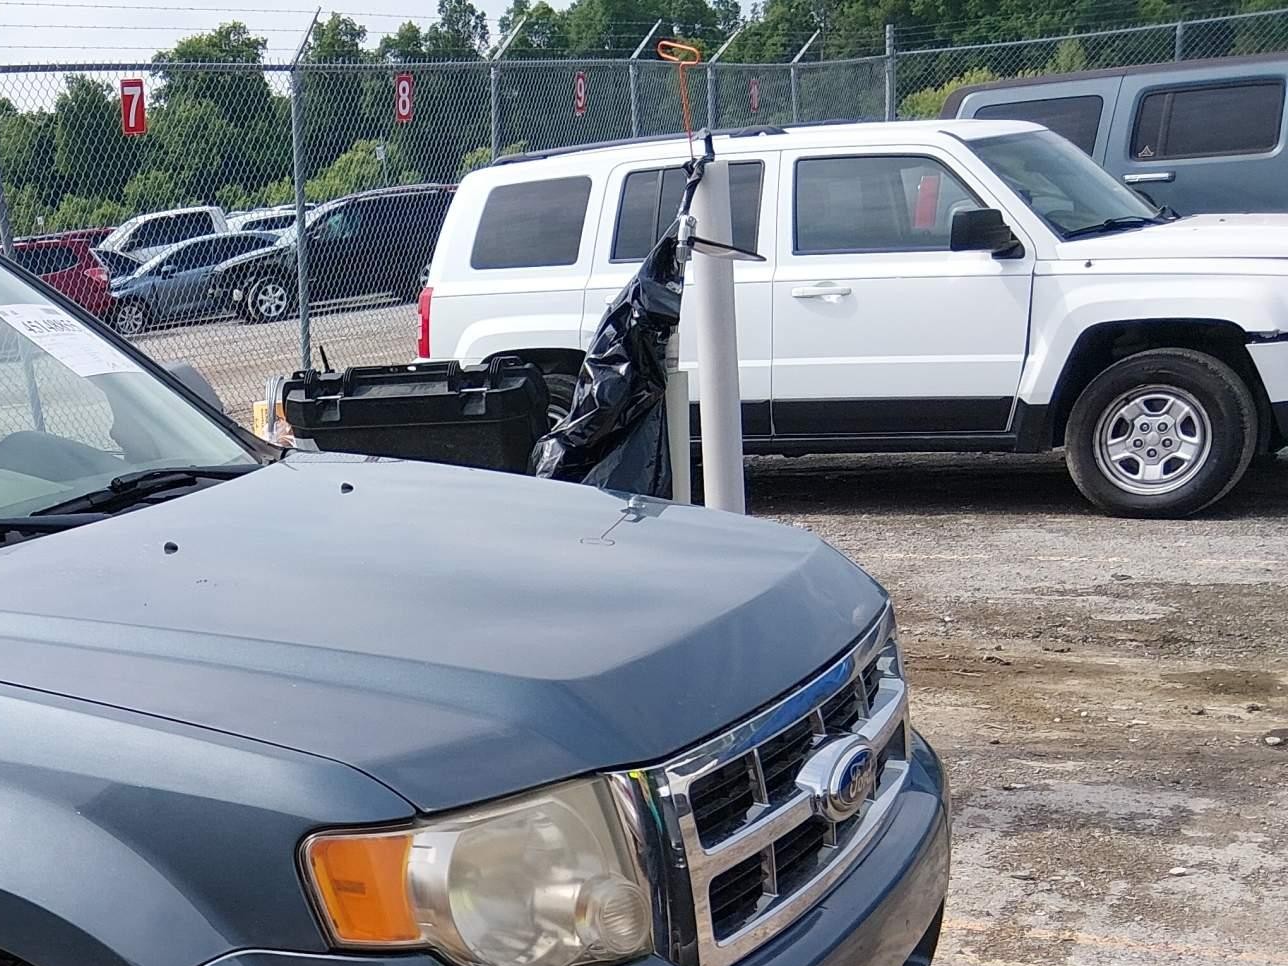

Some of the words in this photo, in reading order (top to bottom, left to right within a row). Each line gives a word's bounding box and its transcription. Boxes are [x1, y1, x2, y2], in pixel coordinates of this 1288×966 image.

[123, 86, 141, 128] 7
[398, 80, 410, 116] 8
[576, 77, 585, 108] 9
[848, 756, 874, 799] Ford
